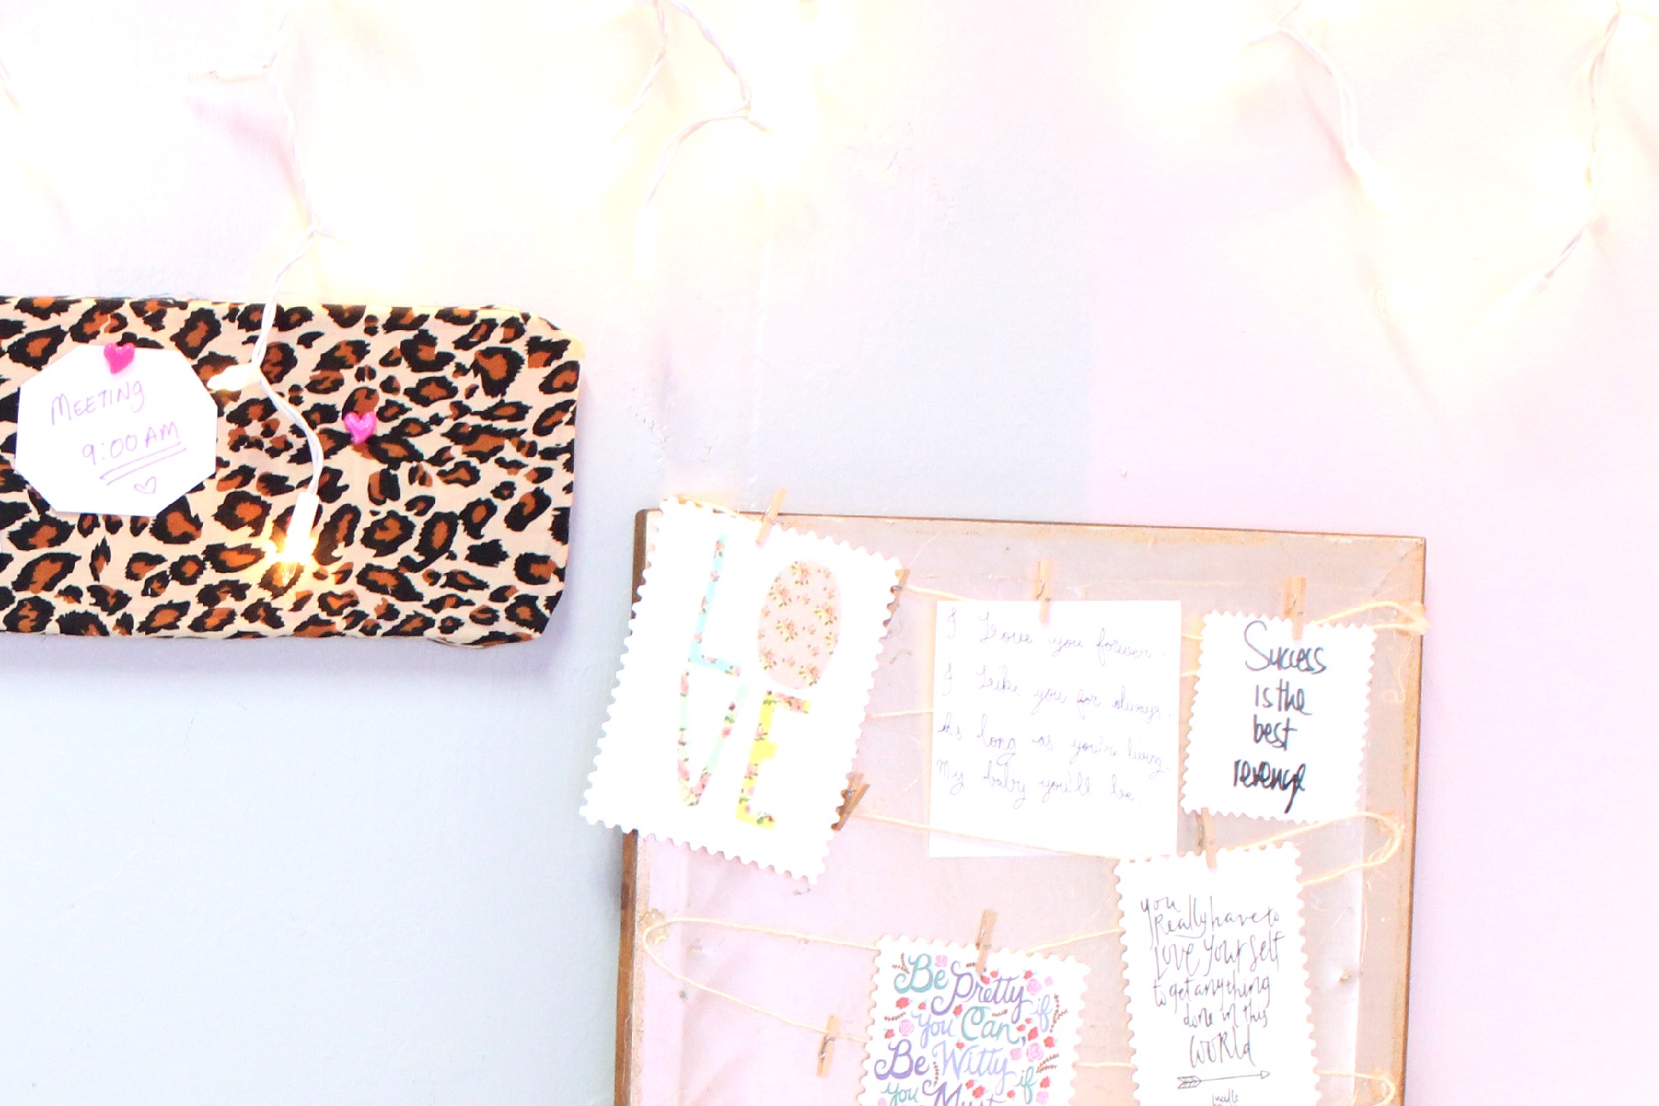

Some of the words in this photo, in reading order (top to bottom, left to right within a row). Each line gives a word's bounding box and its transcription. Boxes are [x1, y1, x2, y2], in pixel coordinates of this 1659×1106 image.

[1049, 636, 1083, 657] you
[1244, 620, 1327, 674] Success
[1032, 688, 1067, 715] you
[1077, 690, 1101, 720] for
[1276, 679, 1312, 715] the
[977, 714, 1016, 765] long
[1032, 735, 1053, 750] as
[1253, 714, 1297, 751] best
[937, 759, 965, 795] My
[984, 760, 1026, 809] baby
[1233, 759, 1307, 814] revenge
[1210, 895, 1259, 931] have
[1260, 907, 1279, 927] to
[893, 953, 949, 994] Be
[931, 961, 1033, 1024] Pretty
[1033, 993, 1050, 1033] if
[1153, 979, 1166, 1007] to
[1169, 977, 1195, 1014] get
[1195, 970, 1270, 1013] anything
[1183, 1003, 1213, 1028] done
[1222, 1003, 1238, 1028] in
[1243, 998, 1267, 1028] this
[874, 1038, 929, 1080] Be
[933, 1041, 1017, 1095] Witty
[1015, 1065, 1034, 1104] if
